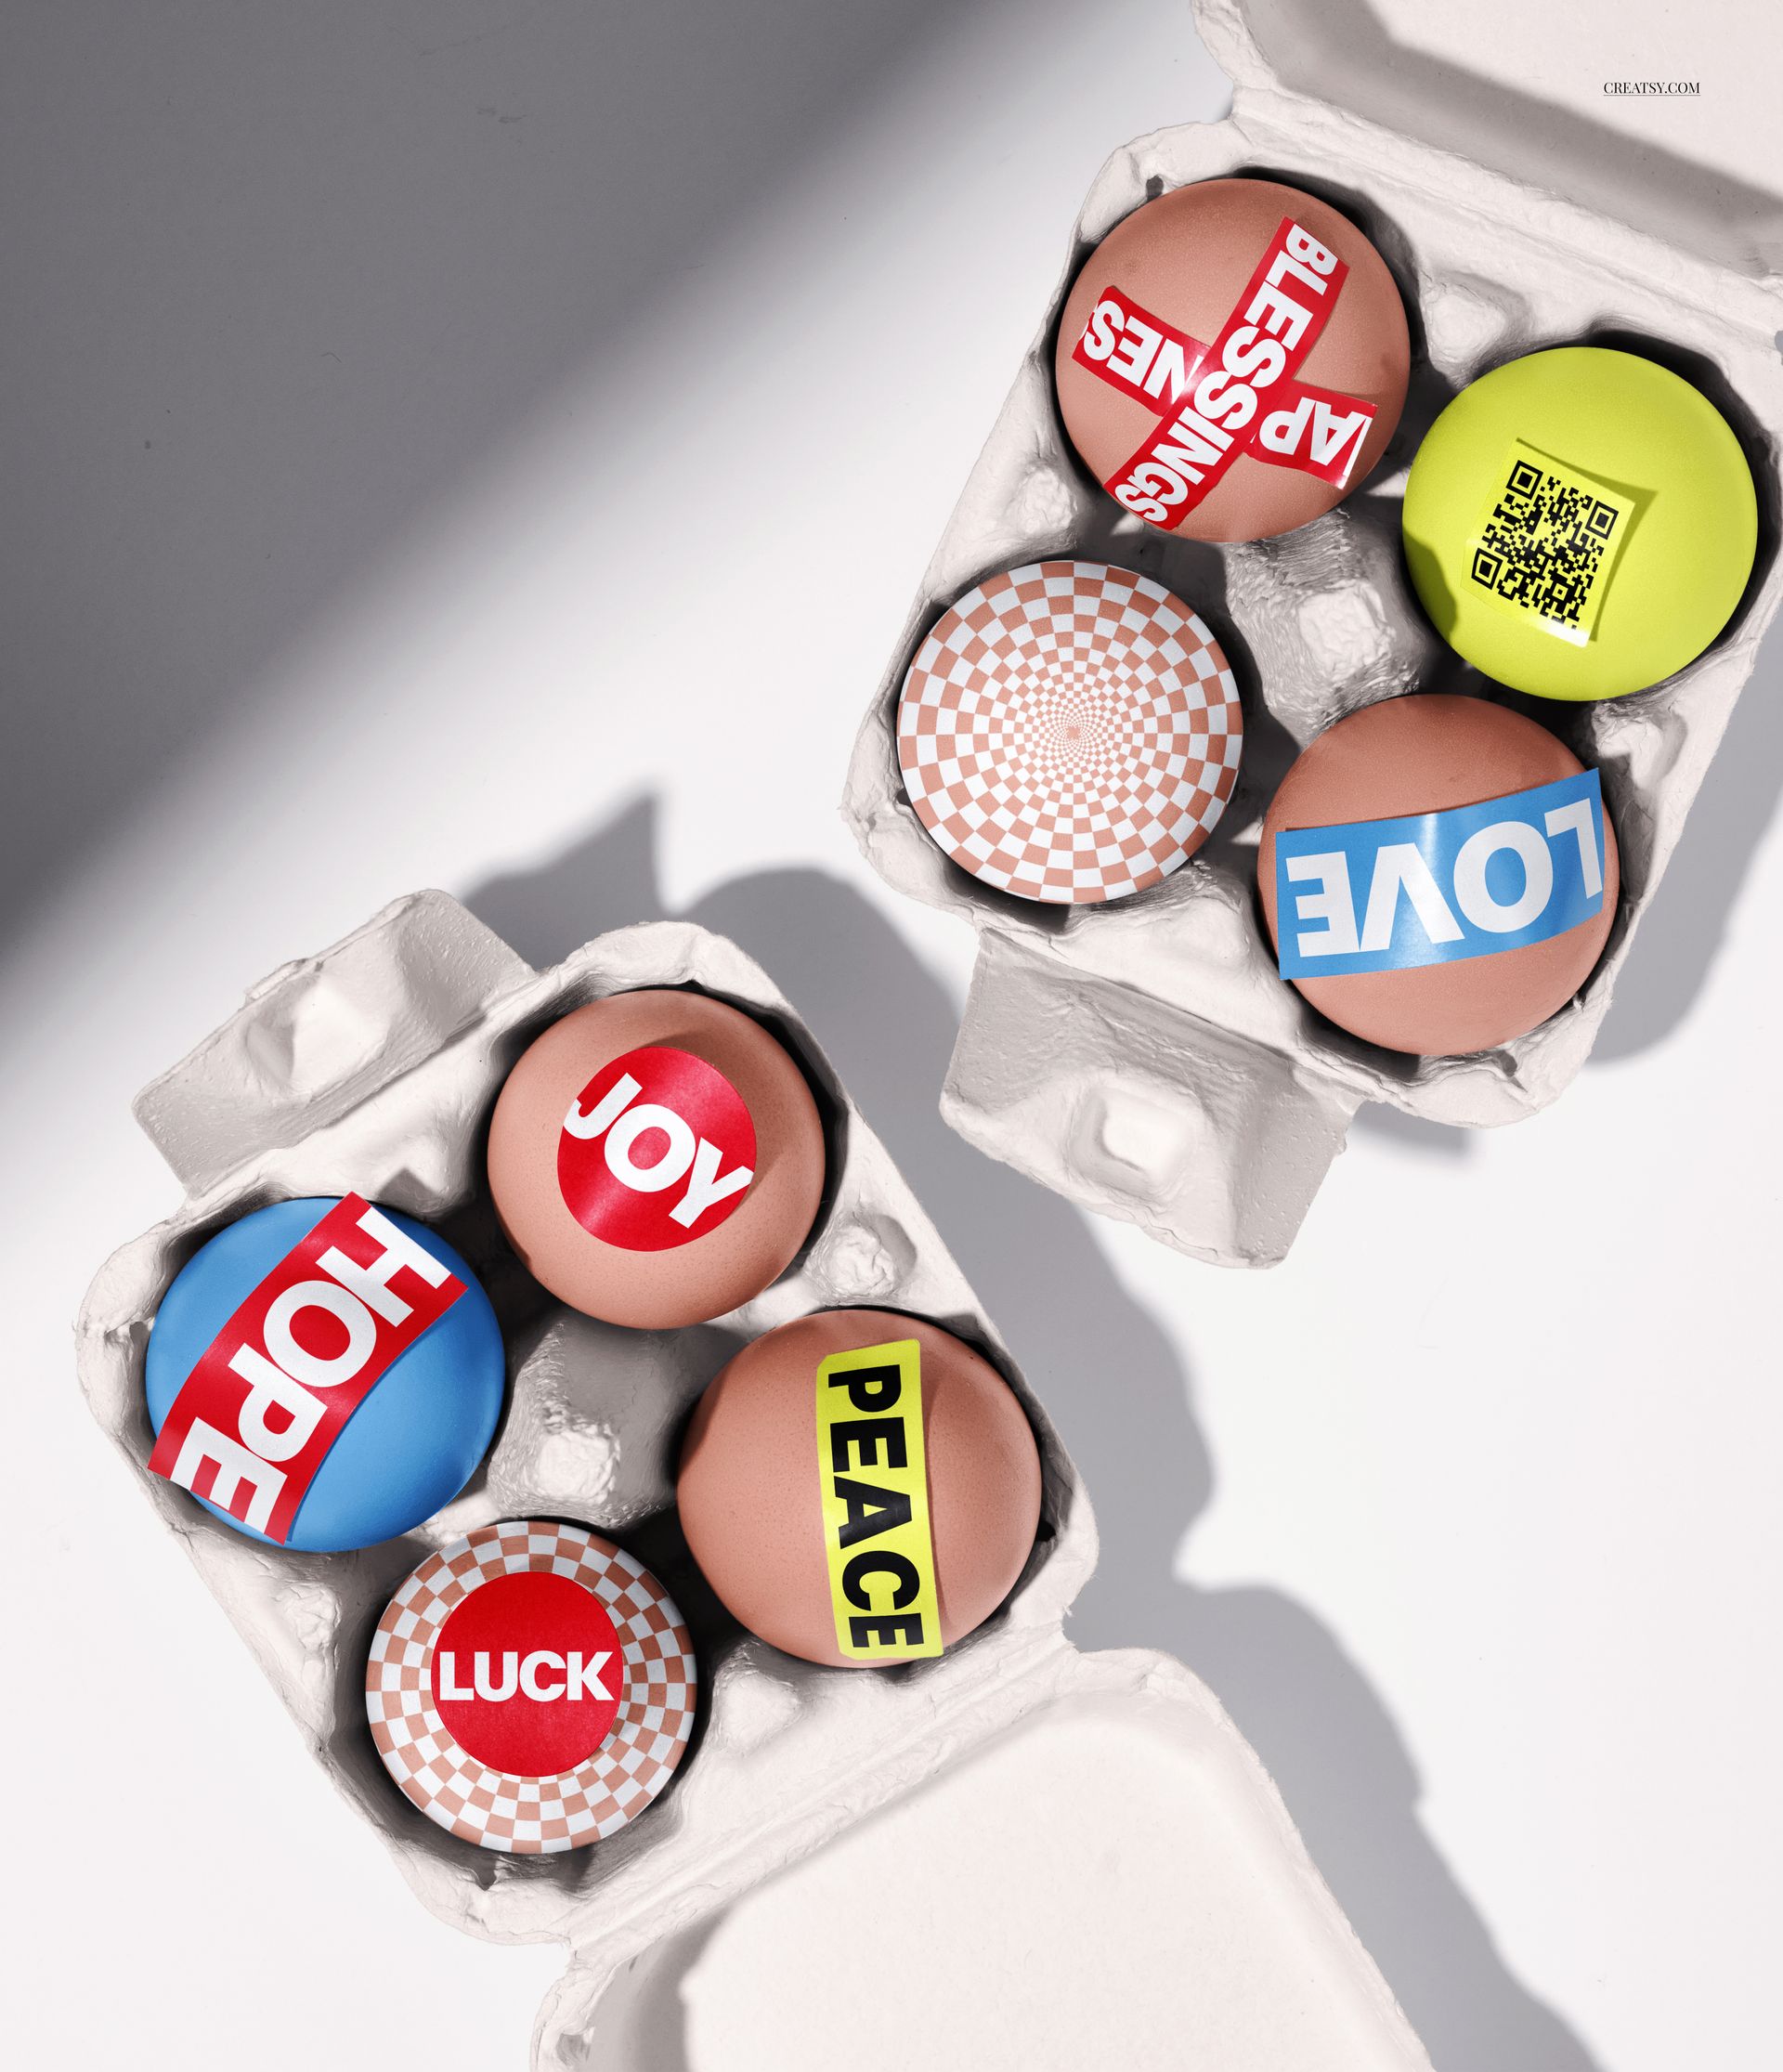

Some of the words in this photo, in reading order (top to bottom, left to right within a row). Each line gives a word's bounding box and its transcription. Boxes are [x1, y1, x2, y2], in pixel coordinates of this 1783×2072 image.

[1114, 224, 1338, 522] BLESSINGS
[1285, 798, 1603, 958] LOVE
[563, 1073, 754, 1229] JOY
[170, 1205, 452, 1535] HOPE
[827, 1364, 925, 1648] PEACE
[439, 1649, 615, 1702] LUCK
